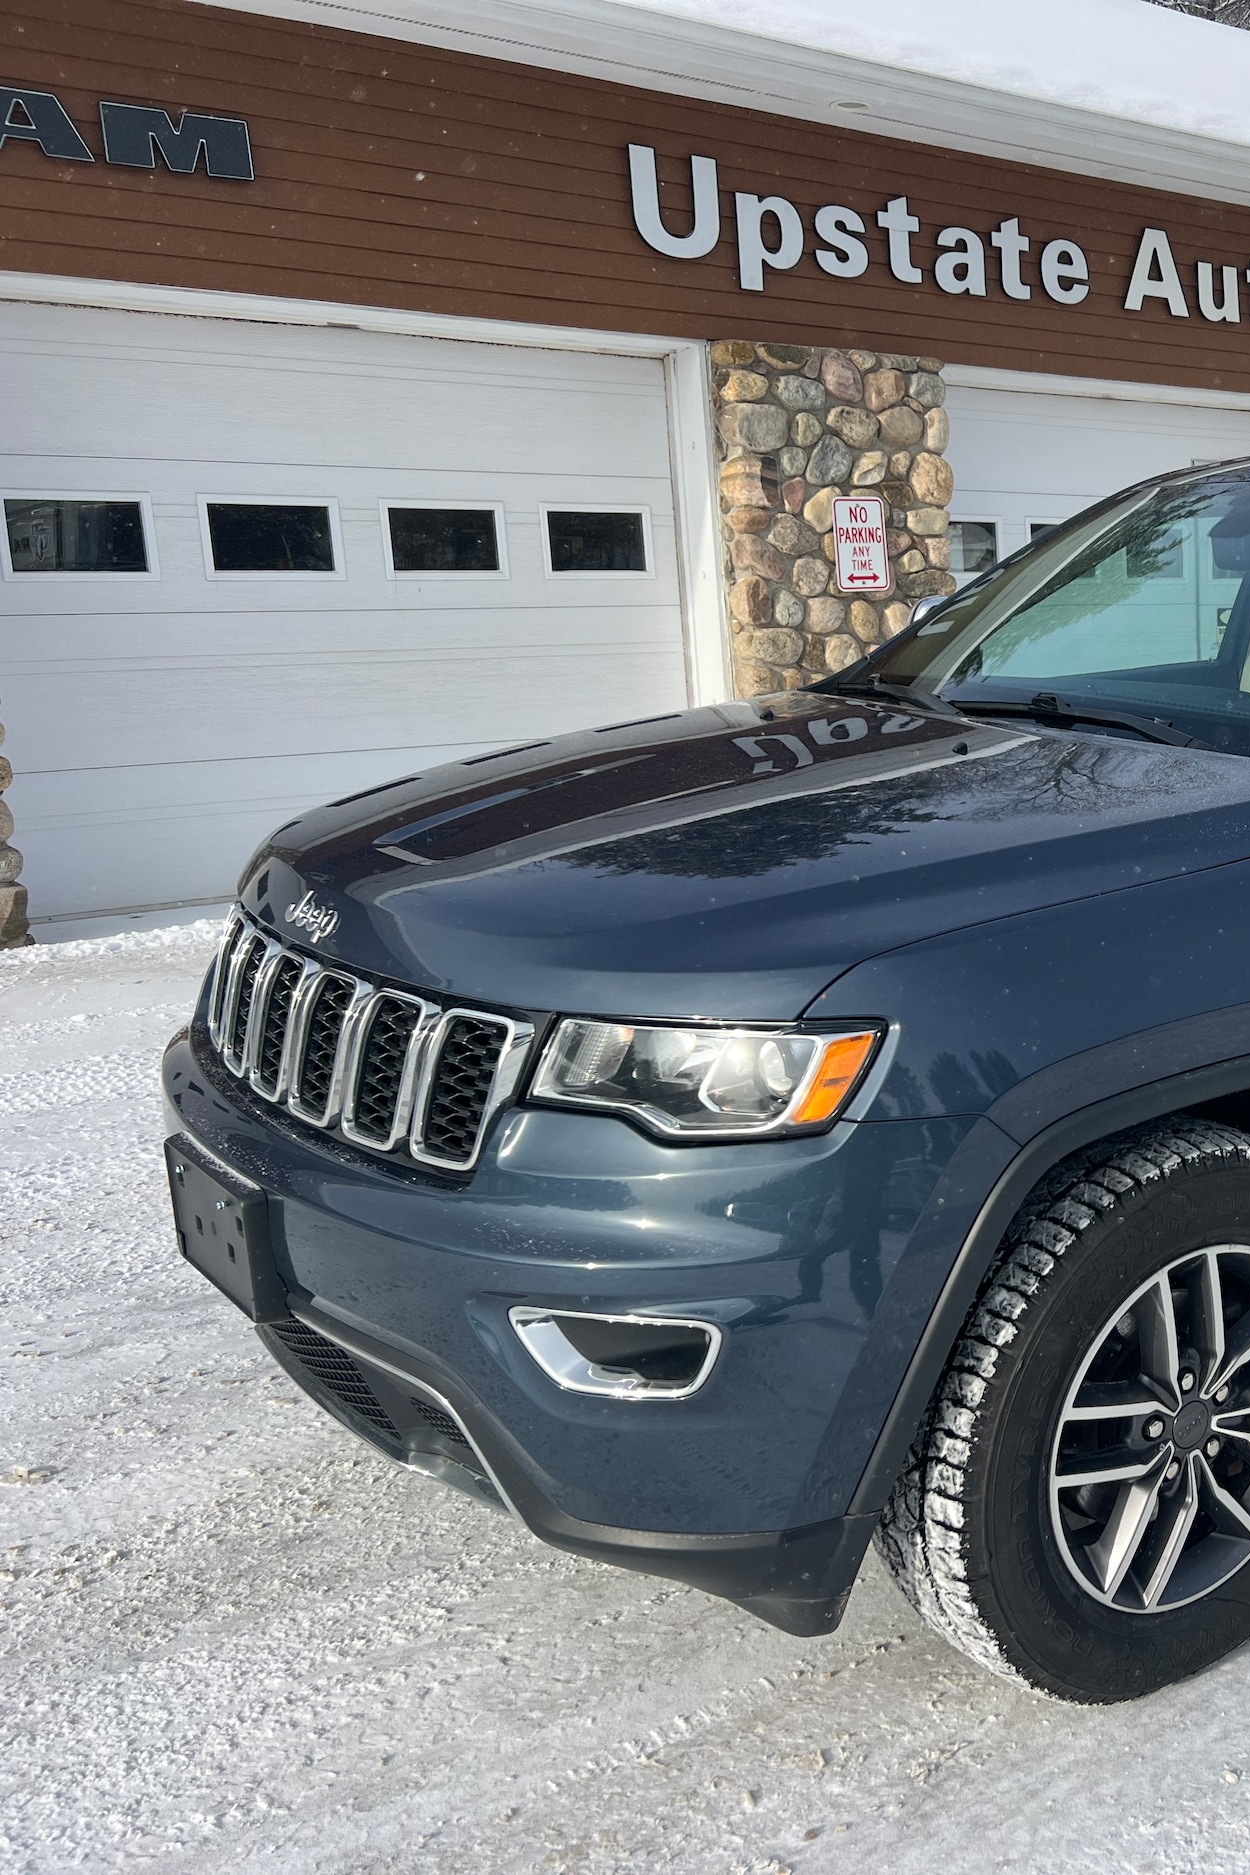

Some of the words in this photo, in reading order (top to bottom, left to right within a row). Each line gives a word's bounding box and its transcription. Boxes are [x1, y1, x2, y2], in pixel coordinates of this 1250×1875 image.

[627, 143, 1091, 305] Upstate
[849, 506, 868, 523] NO
[839, 527, 882, 544] PARKING
[852, 546, 871, 557] ANY
[852, 560, 874, 571] TIME
[285, 890, 339, 944] Jeep
